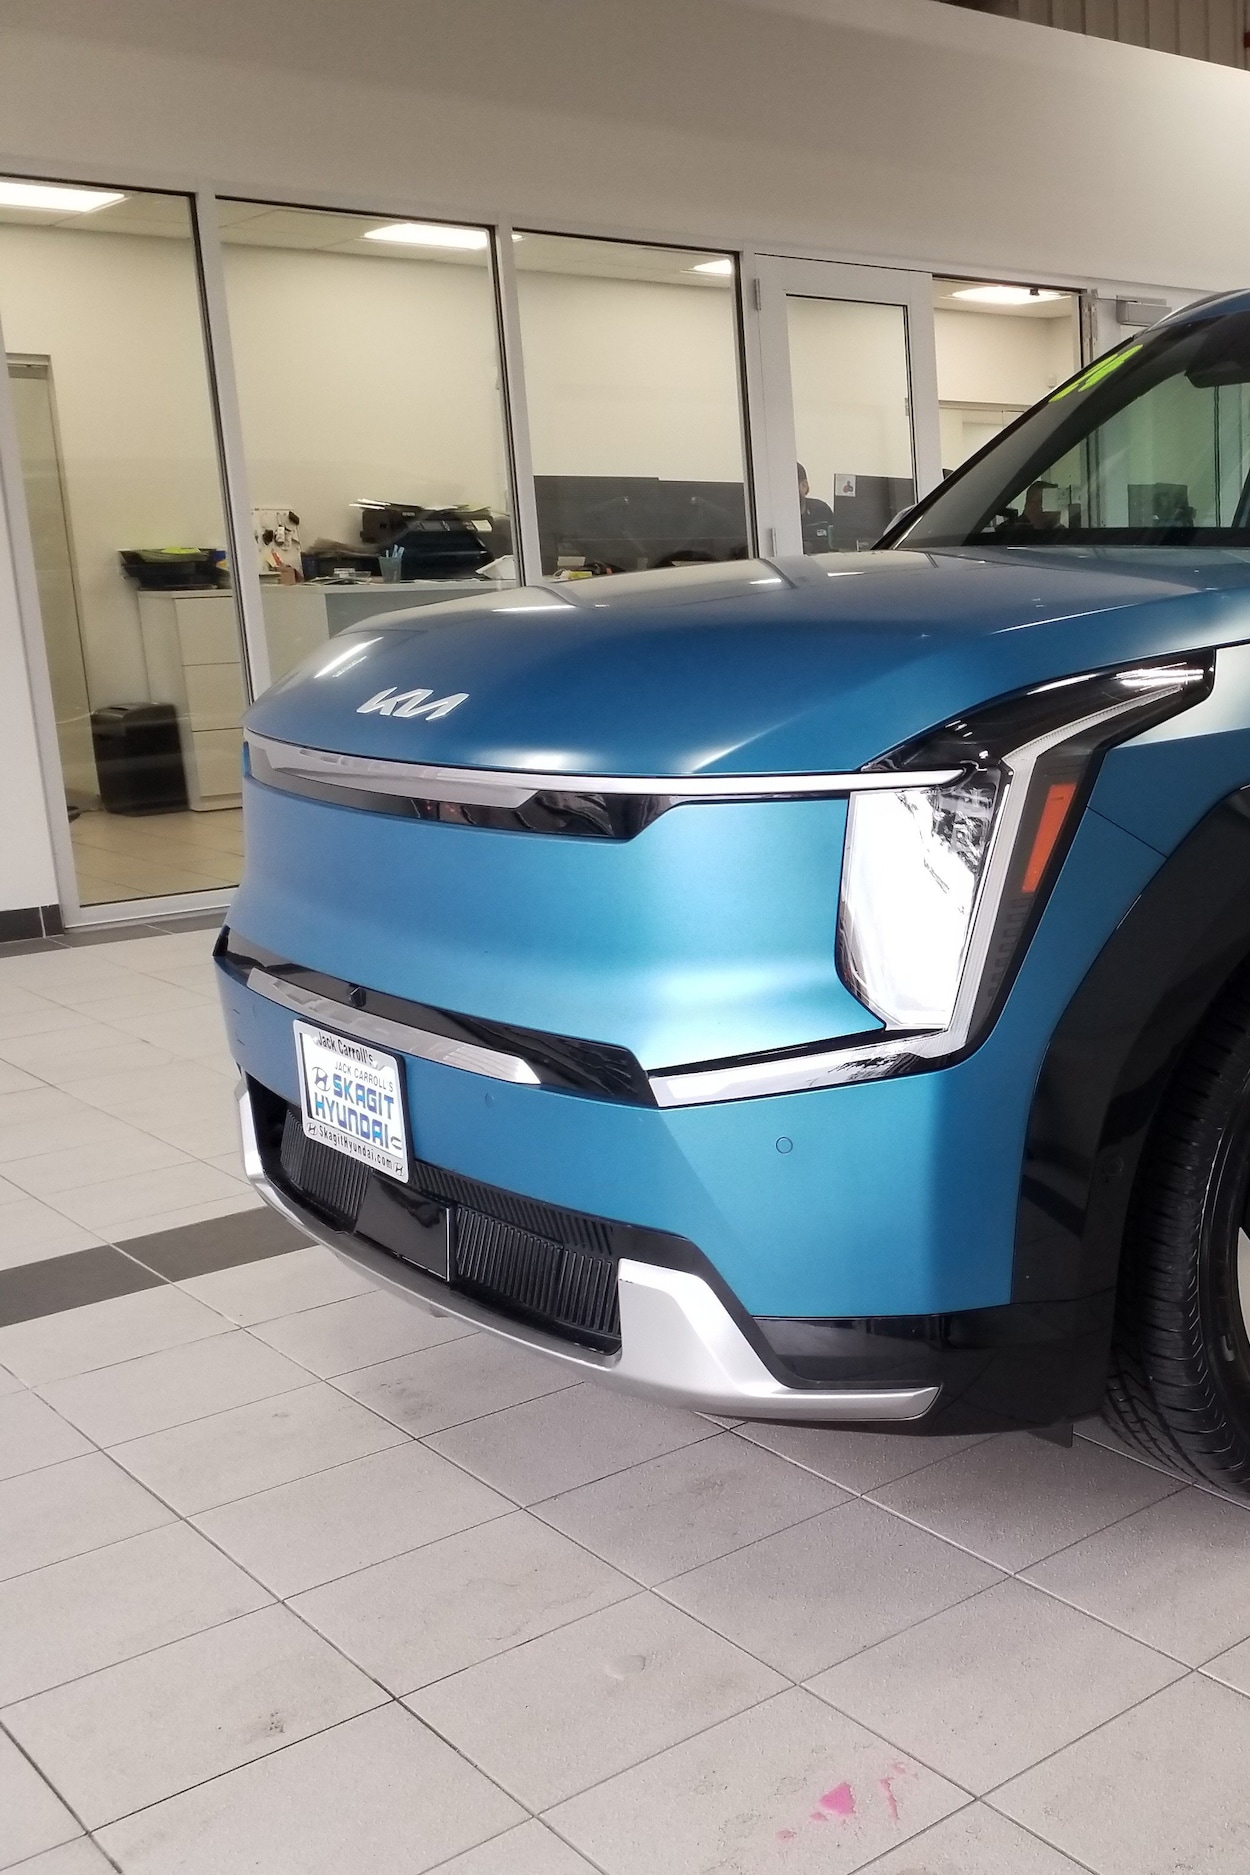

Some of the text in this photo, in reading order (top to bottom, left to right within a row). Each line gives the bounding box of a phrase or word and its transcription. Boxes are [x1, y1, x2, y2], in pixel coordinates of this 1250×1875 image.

[356, 686, 470, 721] KIA
[317, 1032, 374, 1065] Jack Carroll's
[333, 1073, 394, 1120] SKAGIT
[334, 1061, 394, 1092] JACK CARROLL'S
[314, 1092, 389, 1149] HYUNDAI
[318, 1125, 393, 1170] SkagitHyundai.com
